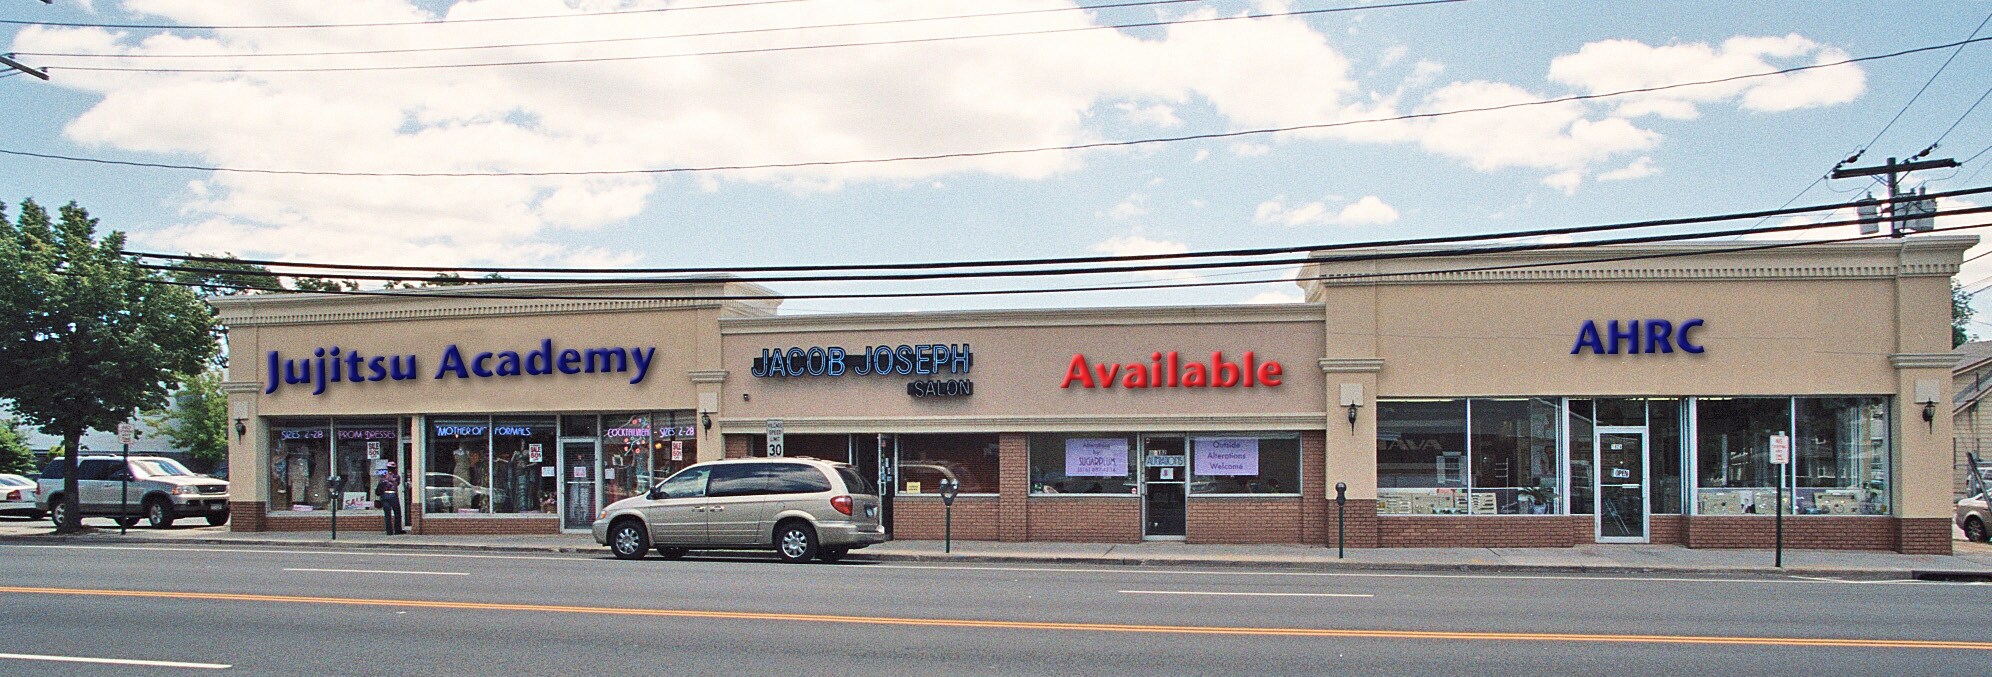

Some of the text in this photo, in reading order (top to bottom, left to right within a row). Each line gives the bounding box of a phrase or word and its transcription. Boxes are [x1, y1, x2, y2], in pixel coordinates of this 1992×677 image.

[1570, 318, 1705, 355] AHRC
[265, 338, 656, 396] Jujitsu Academy
[752, 343, 971, 379] JACOB JOSEPH
[1060, 350, 1284, 390] Available
[914, 378, 971, 398] SALON
[281, 430, 301, 440] SIZES
[364, 430, 397, 440] DRESSES
[494, 426, 532, 437] FORMALS
[769, 443, 782, 456] 30
[1213, 441, 1241, 449] Outside
[1210, 462, 1244, 470] Welcome
